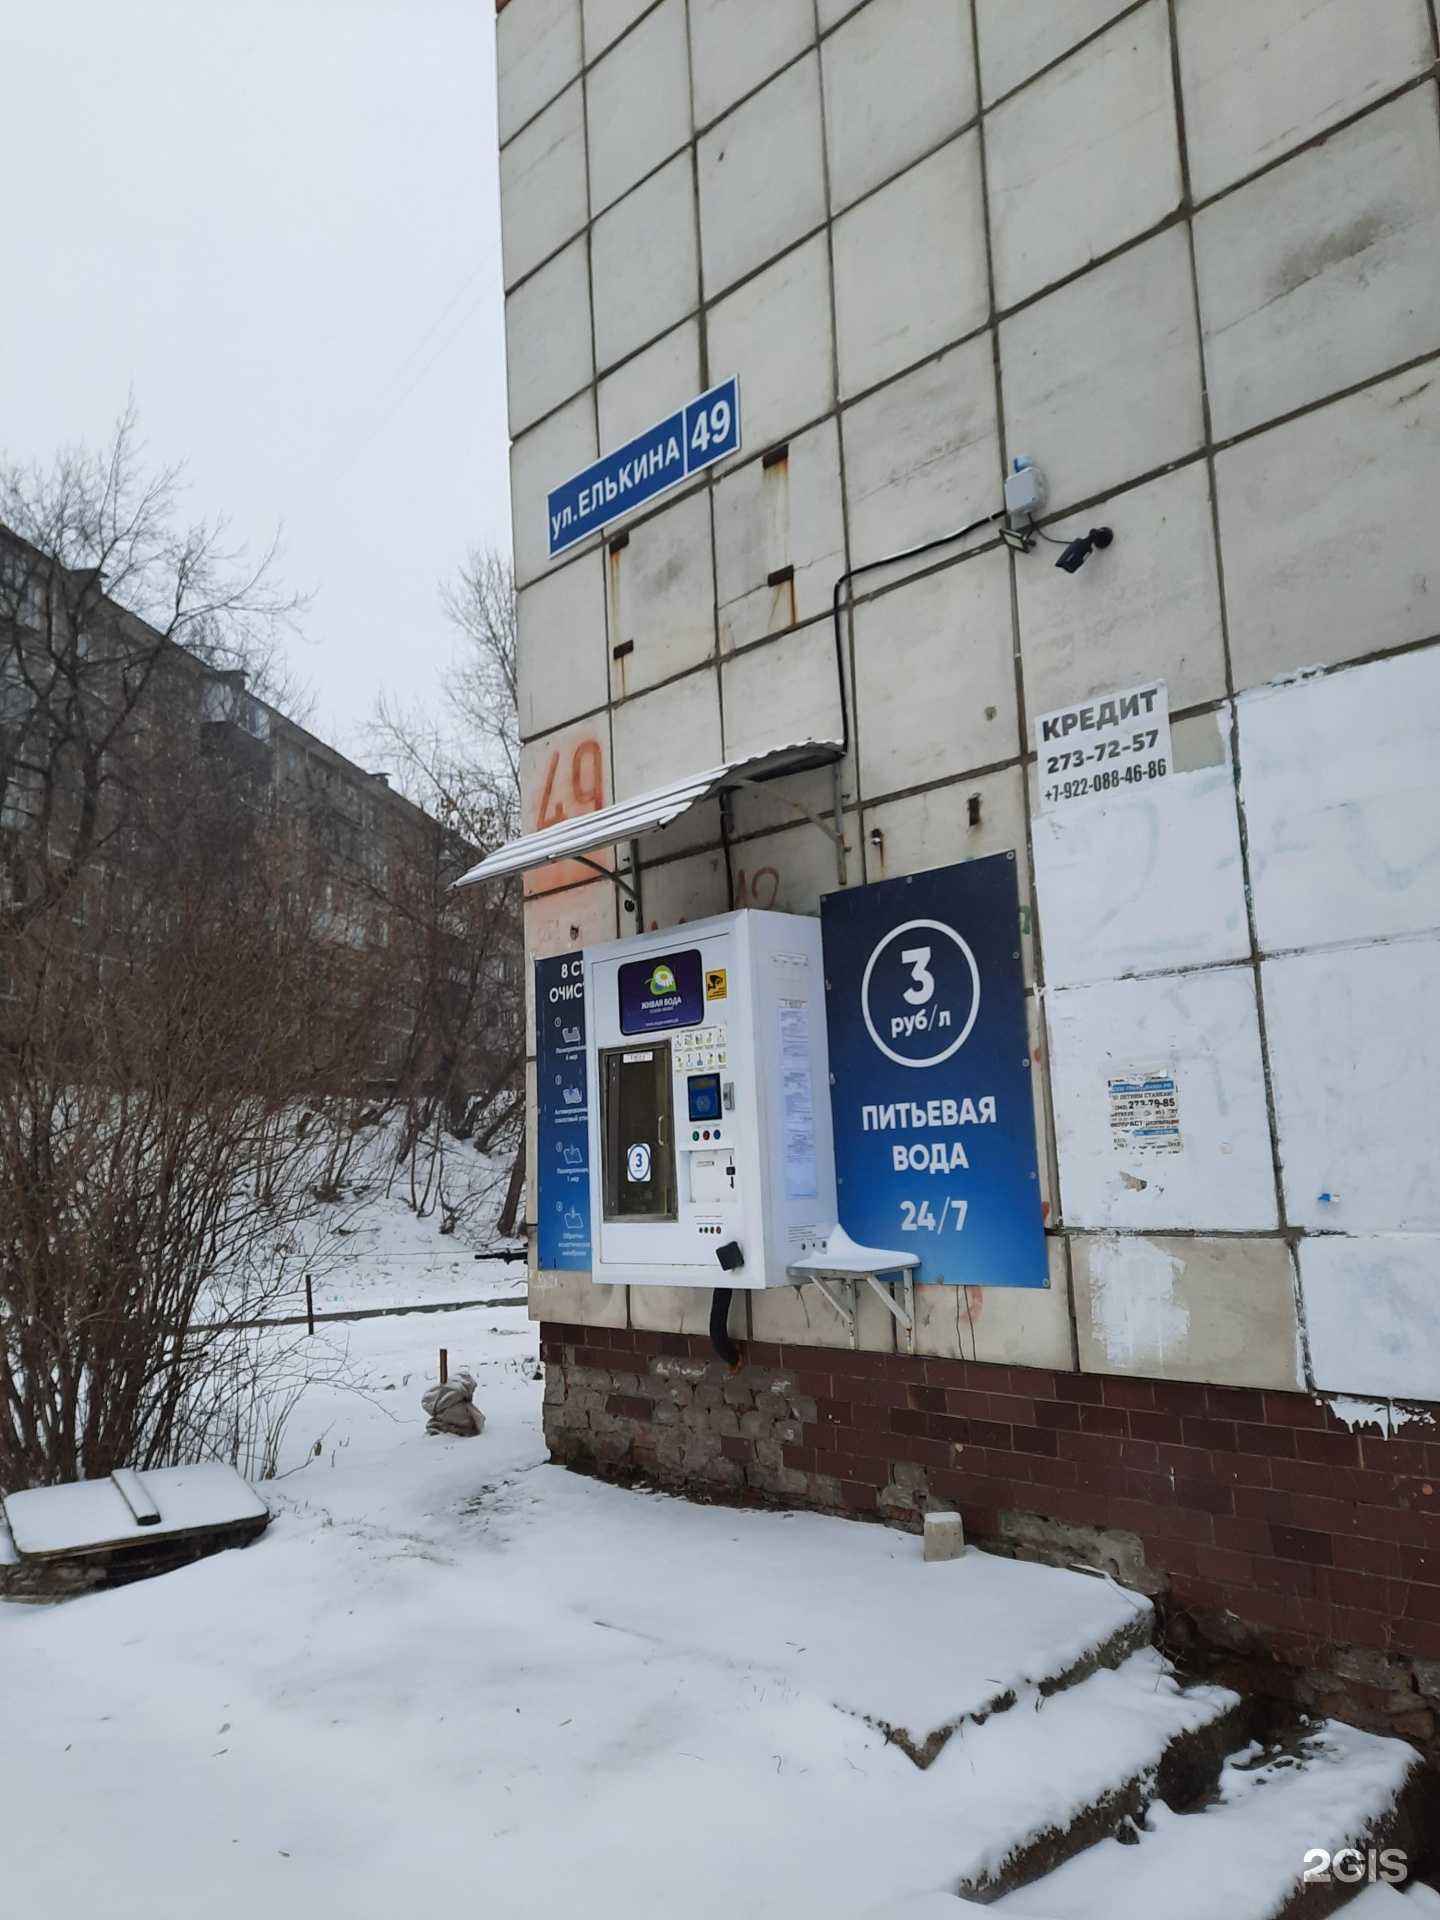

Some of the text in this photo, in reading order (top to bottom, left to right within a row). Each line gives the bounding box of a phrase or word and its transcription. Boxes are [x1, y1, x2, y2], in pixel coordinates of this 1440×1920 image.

[691, 399, 732, 452] 49
[1042, 688, 1158, 742] КРЕДИТ
[1047, 729, 1159, 774] 273-72-57
[1045, 758, 1167, 803] +7-922-088-46-86
[560, 963, 569, 979] 8
[900, 946, 936, 1006] 3
[549, 983, 585, 1003] ОЧИС
[664, 996, 682, 1007] ВОДА
[890, 1004, 952, 1039] руб/л
[861, 1095, 997, 1132] ПИТЬЕВАЯ
[635, 1152, 643, 1168] 3
[892, 1142, 970, 1175] ВОДА
[899, 1195, 968, 1235] 24/7
